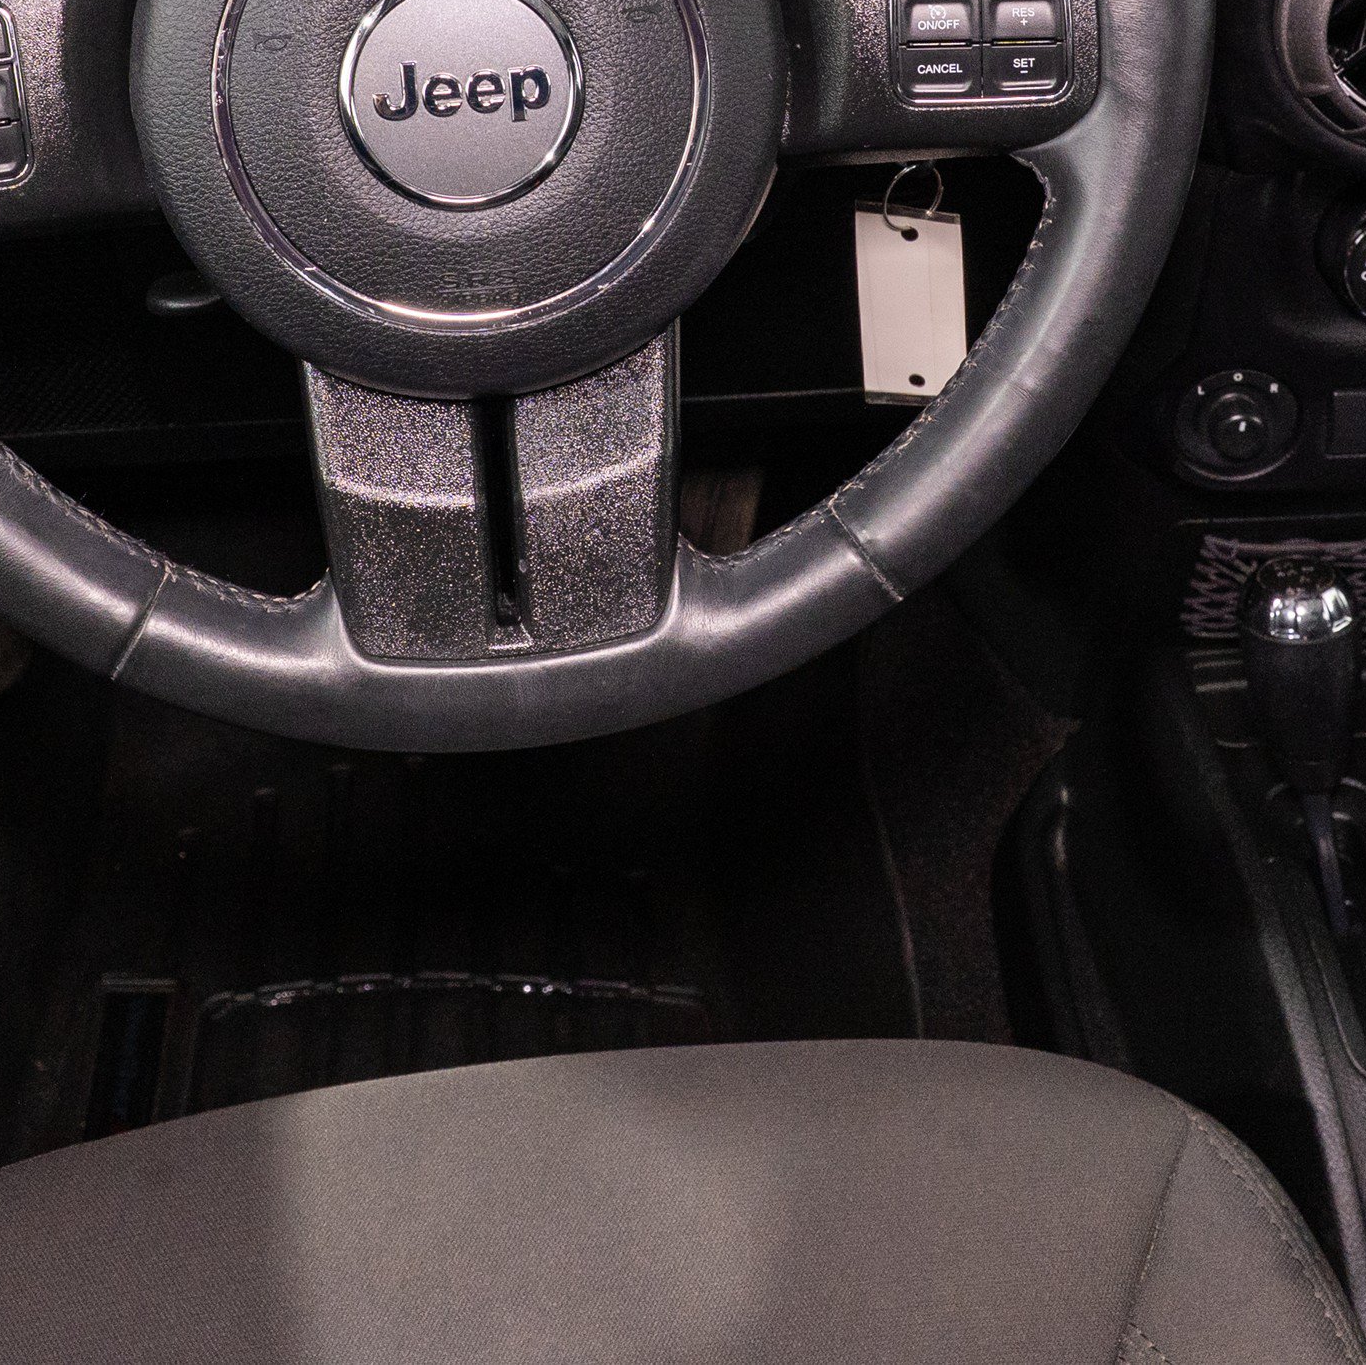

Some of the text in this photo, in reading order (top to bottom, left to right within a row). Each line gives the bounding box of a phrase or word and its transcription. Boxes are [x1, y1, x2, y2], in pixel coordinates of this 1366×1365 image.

[1011, 7, 1035, 17] RES
[917, 19, 960, 31] ON/OFF
[1013, 57, 1035, 68] SET
[917, 63, 963, 75] CANCEL
[372, 60, 552, 122] Jeep
[1197, 385, 1205, 396] L
